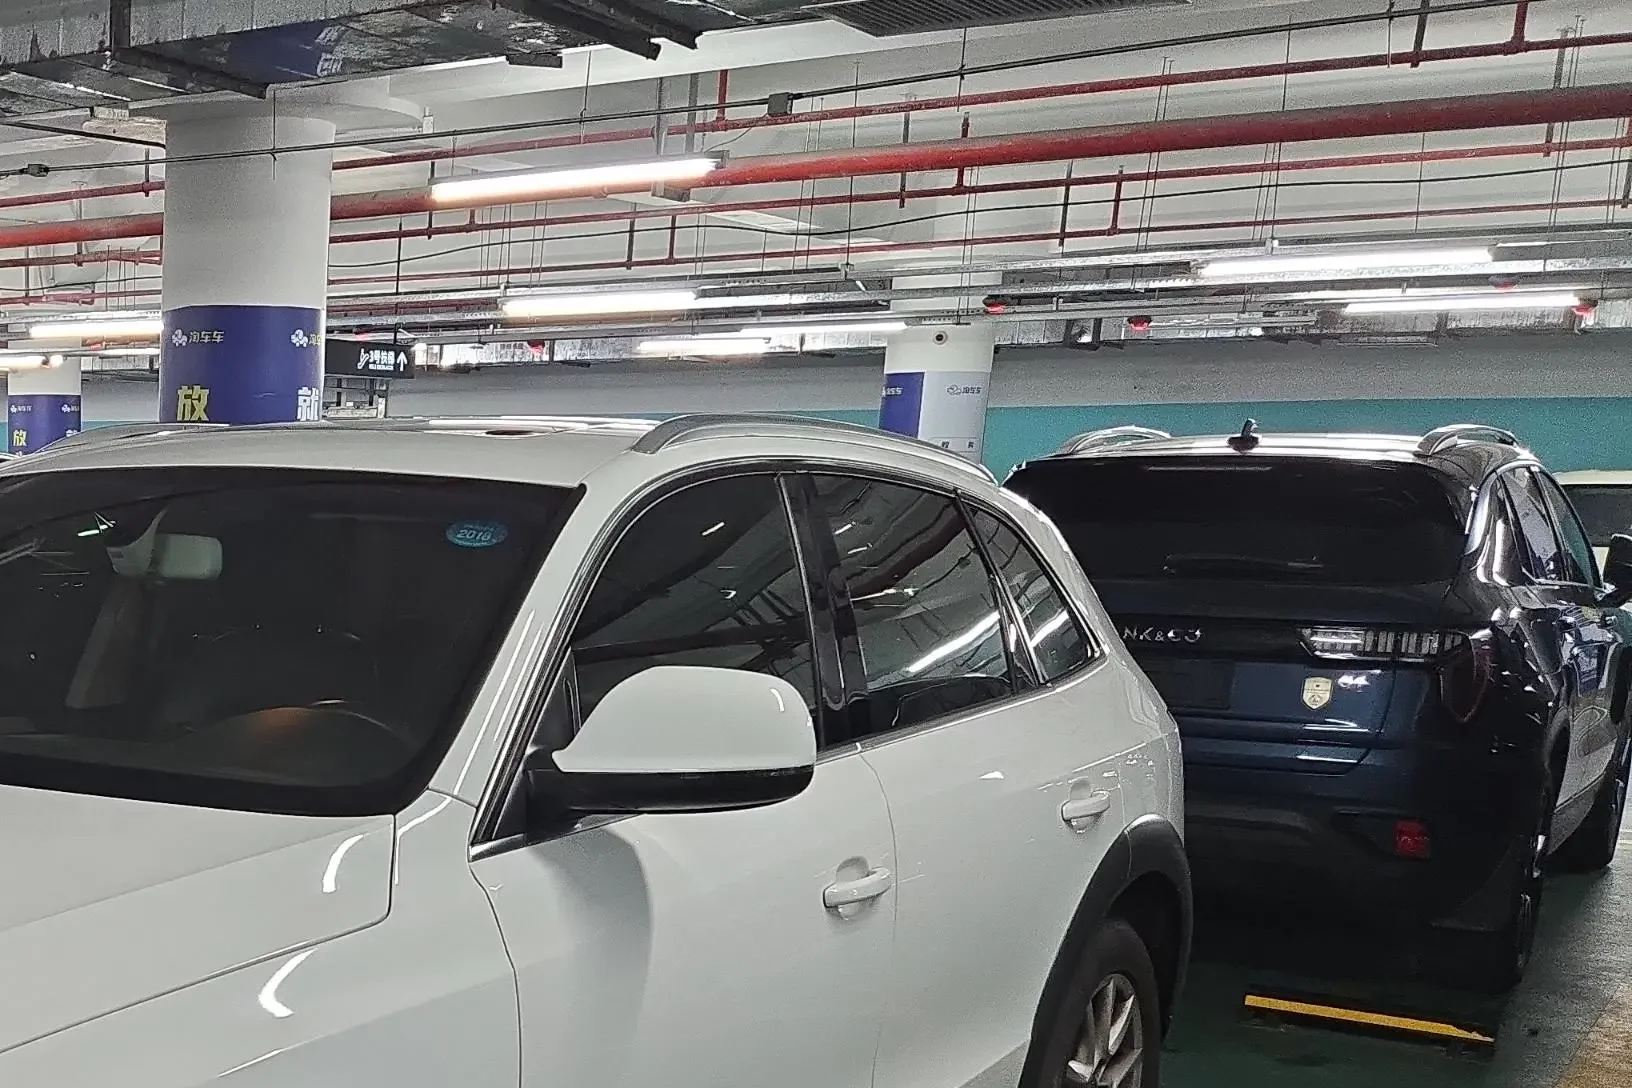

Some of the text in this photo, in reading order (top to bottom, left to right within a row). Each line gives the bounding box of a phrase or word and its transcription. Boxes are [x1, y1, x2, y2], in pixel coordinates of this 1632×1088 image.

[189, 331, 225, 343] 淘车车
[176, 385, 210, 422] 放
